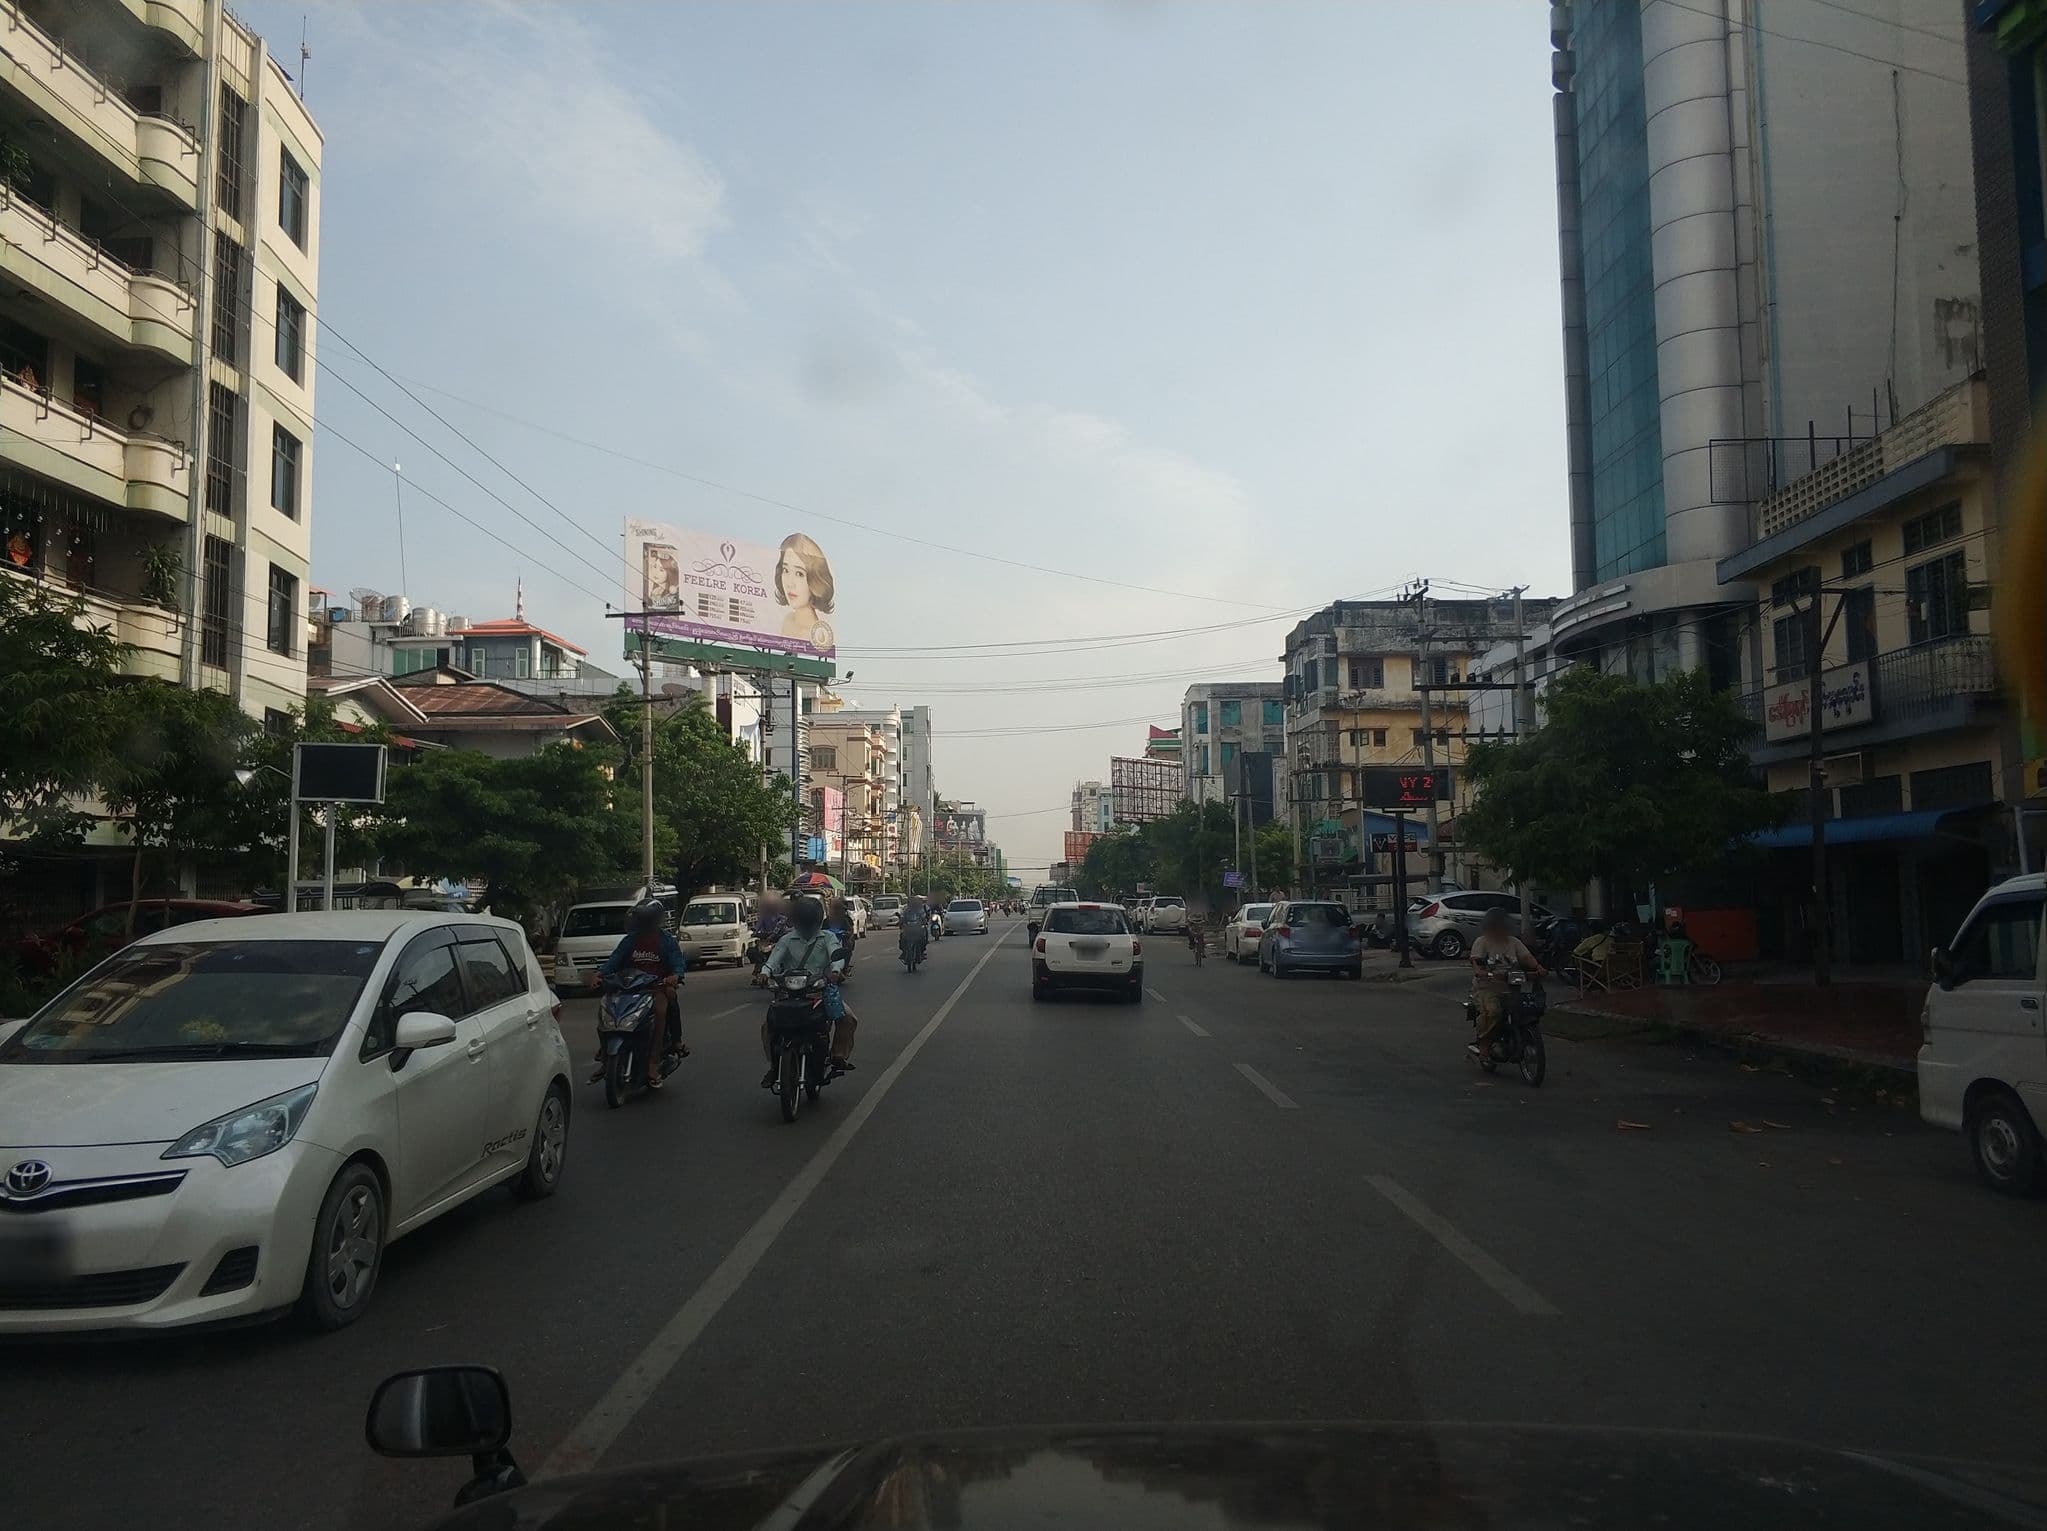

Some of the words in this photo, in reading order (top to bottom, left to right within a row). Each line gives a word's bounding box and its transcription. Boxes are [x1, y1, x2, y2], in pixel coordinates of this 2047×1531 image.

[684, 573, 727, 591] FEELRE
[733, 581, 768, 598] KOREA
[480, 1128, 528, 1158] Ractis
